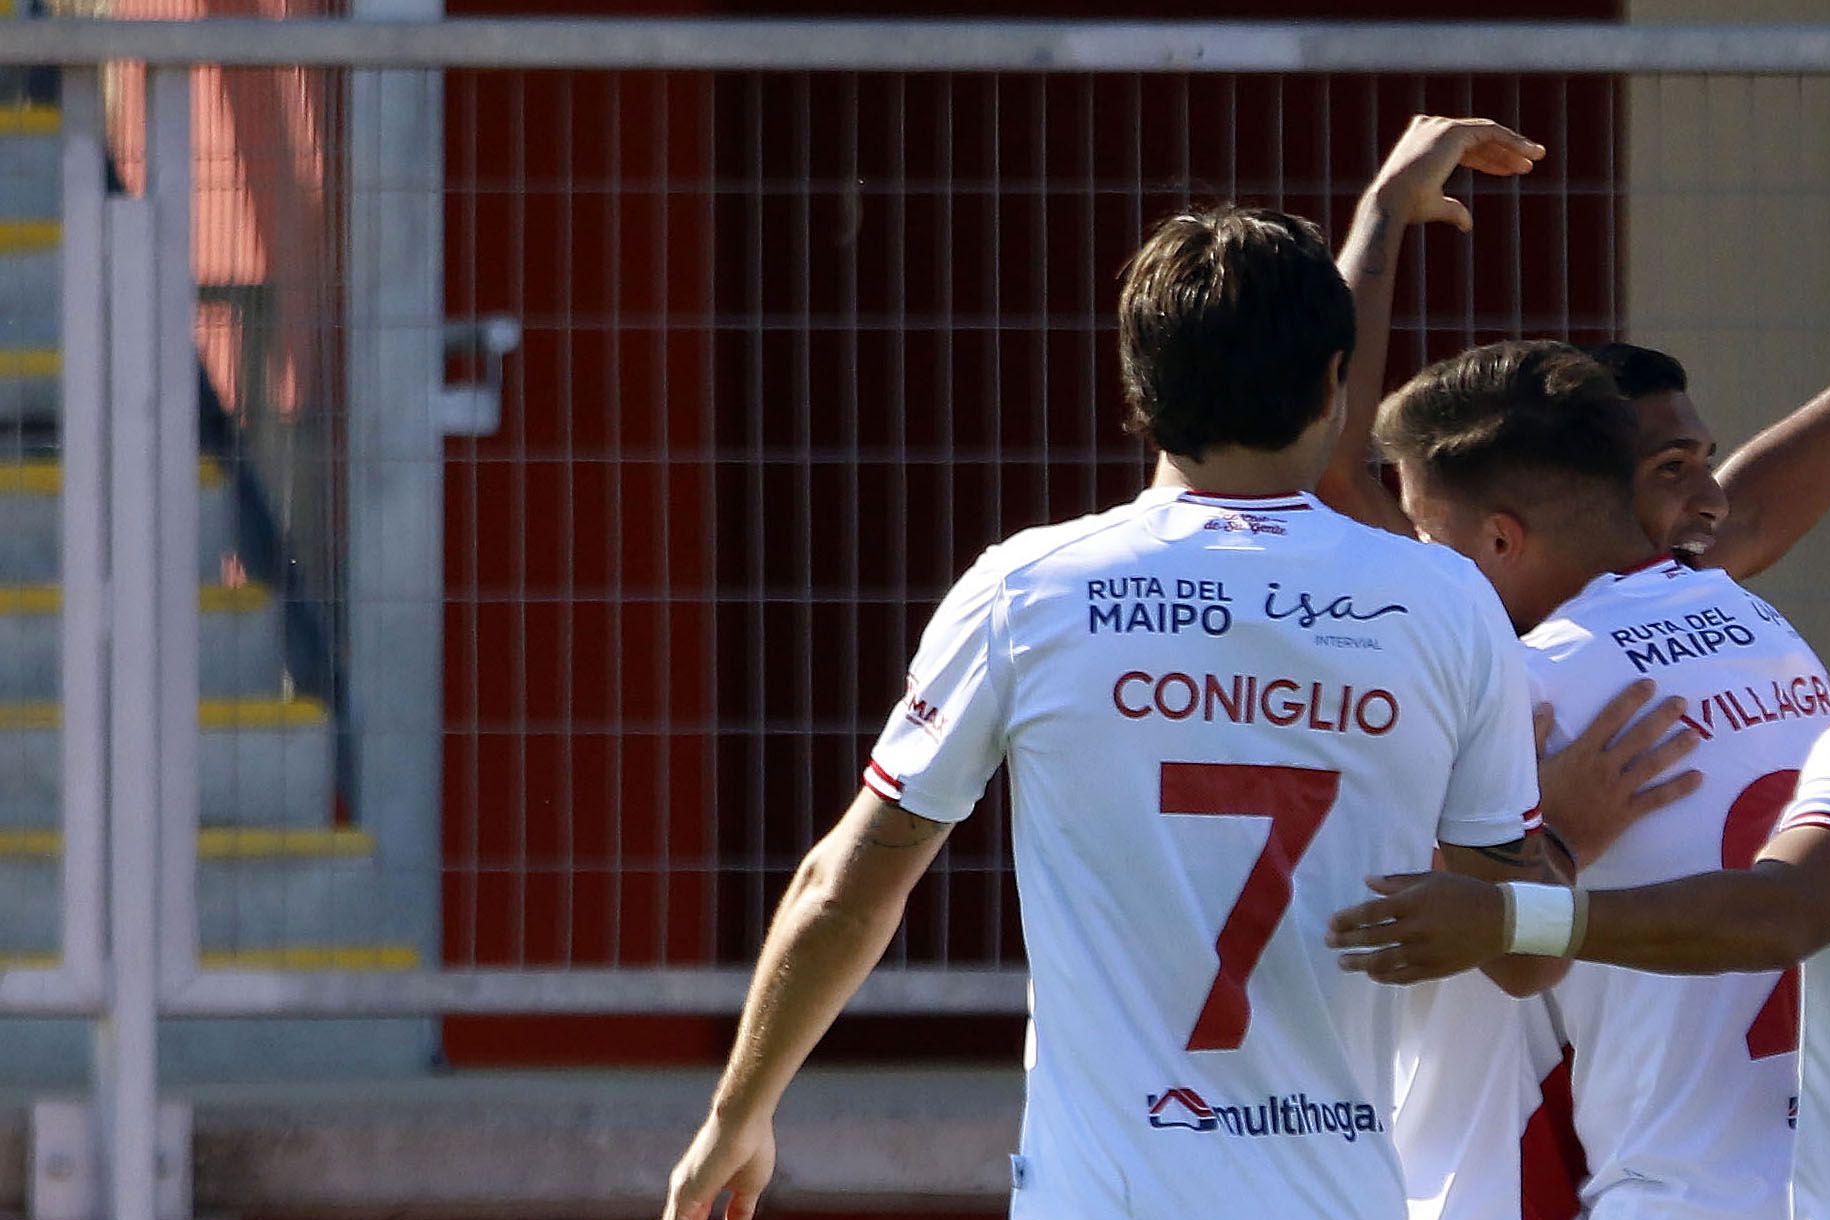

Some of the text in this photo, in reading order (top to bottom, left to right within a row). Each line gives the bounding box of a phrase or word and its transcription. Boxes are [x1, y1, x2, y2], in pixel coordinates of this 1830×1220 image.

[1088, 577, 1233, 602] RUTA DEL
[1089, 602, 1234, 637] MAIPO
[1610, 606, 1736, 648] RUTA DEL
[1625, 623, 1756, 674] MAIPO
[1113, 670, 1400, 737] CONIGLIO
[1159, 761, 1342, 1052] 7
[1213, 1092, 1384, 1142] multihoga
